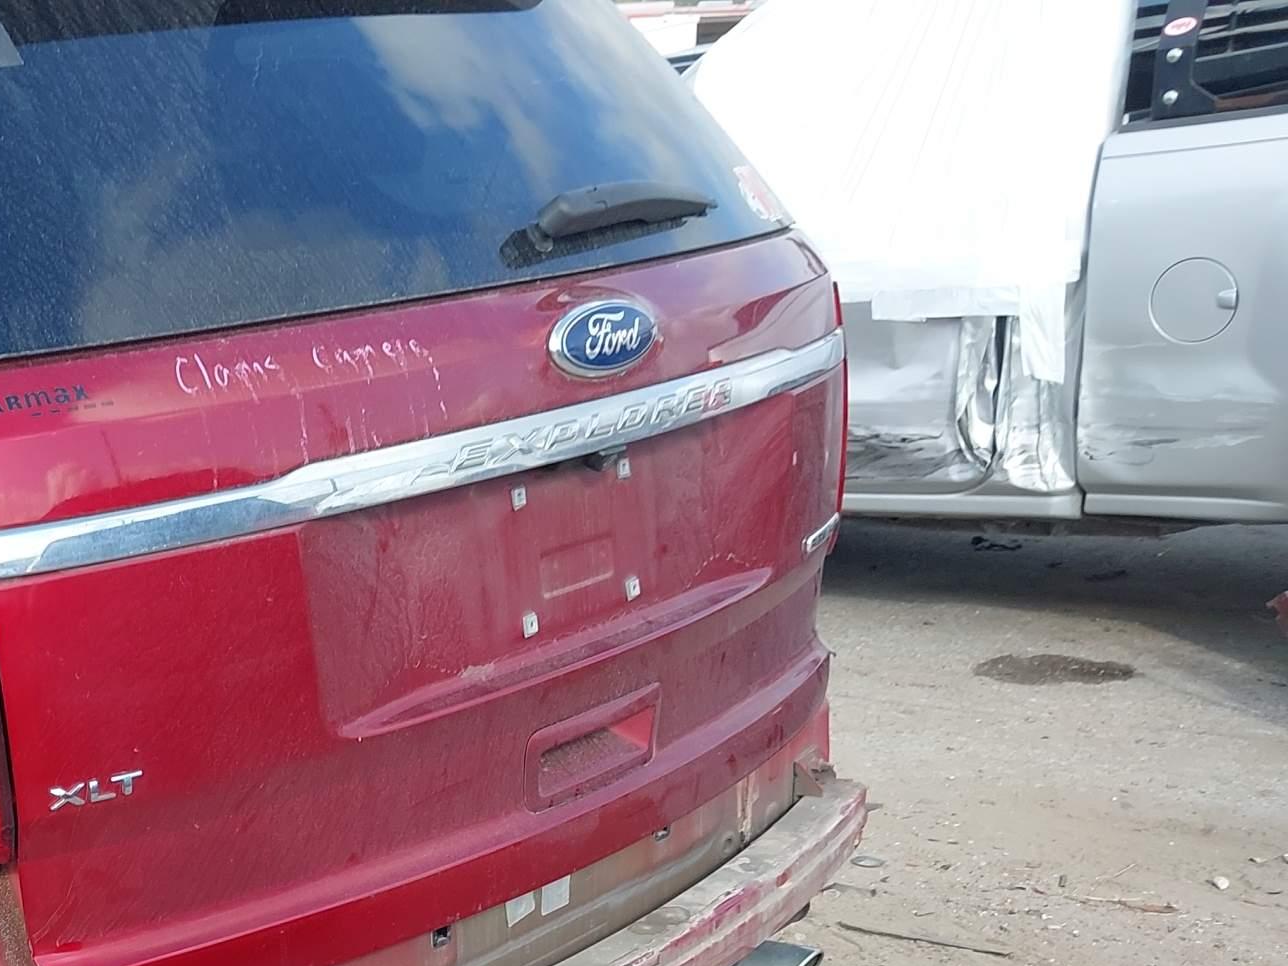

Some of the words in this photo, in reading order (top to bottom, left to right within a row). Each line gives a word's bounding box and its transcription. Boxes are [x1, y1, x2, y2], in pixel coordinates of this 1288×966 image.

[585, 310, 642, 359] Ford
[450, 377, 734, 473] EXPLORER
[49, 769, 144, 811] XLT
